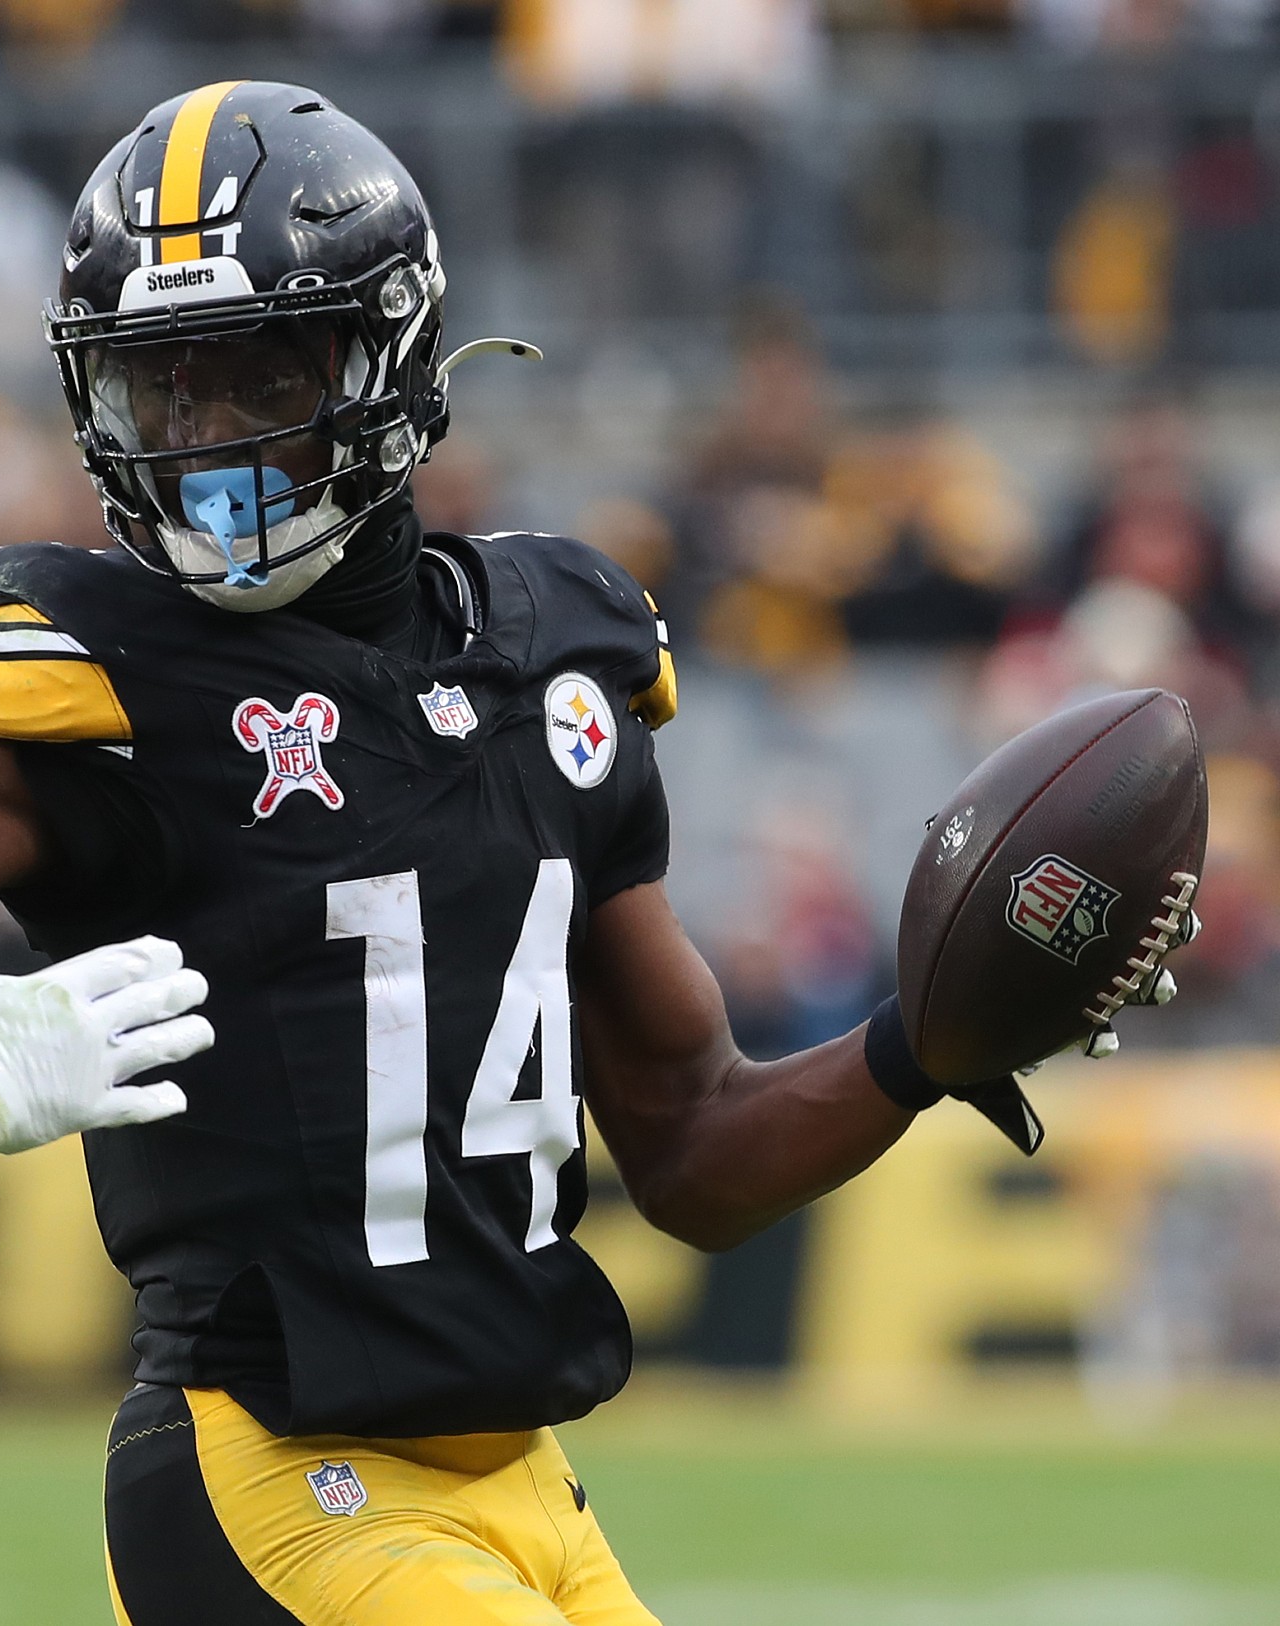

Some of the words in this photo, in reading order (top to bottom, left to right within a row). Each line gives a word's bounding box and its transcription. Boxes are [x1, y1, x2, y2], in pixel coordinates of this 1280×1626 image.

[134, 176, 242, 267] 14
[146, 266, 215, 292] Steelers
[434, 706, 470, 728] NFL
[551, 714, 578, 733] Steelers
[275, 747, 313, 775] NFL
[940, 815, 963, 850] 297
[1015, 863, 1083, 932] NFL
[325, 858, 581, 1267] 14
[322, 1481, 360, 1506] NFL
